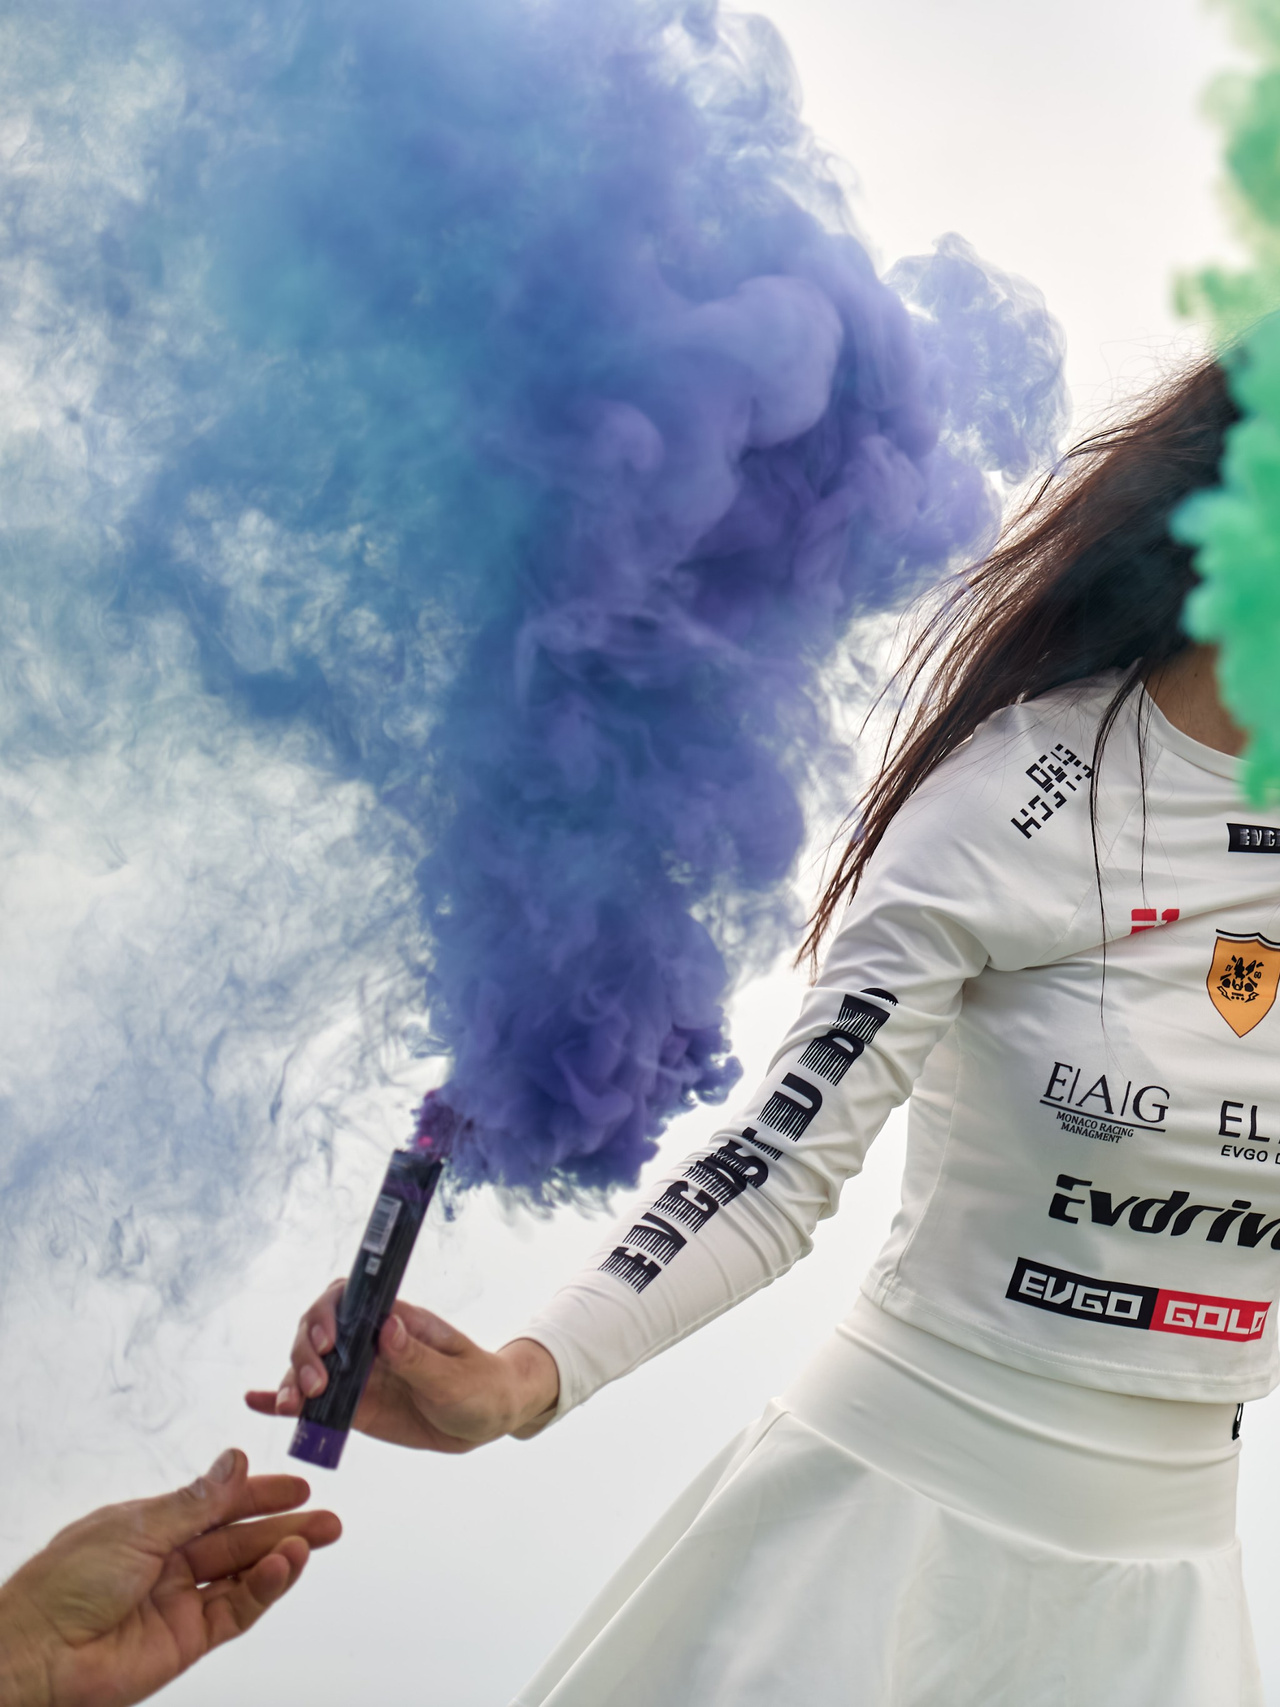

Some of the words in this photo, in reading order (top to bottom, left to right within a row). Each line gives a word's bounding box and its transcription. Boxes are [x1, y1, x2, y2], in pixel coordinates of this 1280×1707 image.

[1056, 1111, 1098, 1130] MONACO
[1099, 1122, 1134, 1138] RACING
[1061, 1122, 1122, 1143] MANAGMENT
[1221, 1145, 1268, 1162] EVGO
[1018, 1269, 1143, 1320] EVGO
[1163, 1300, 1268, 1335] GOLD
